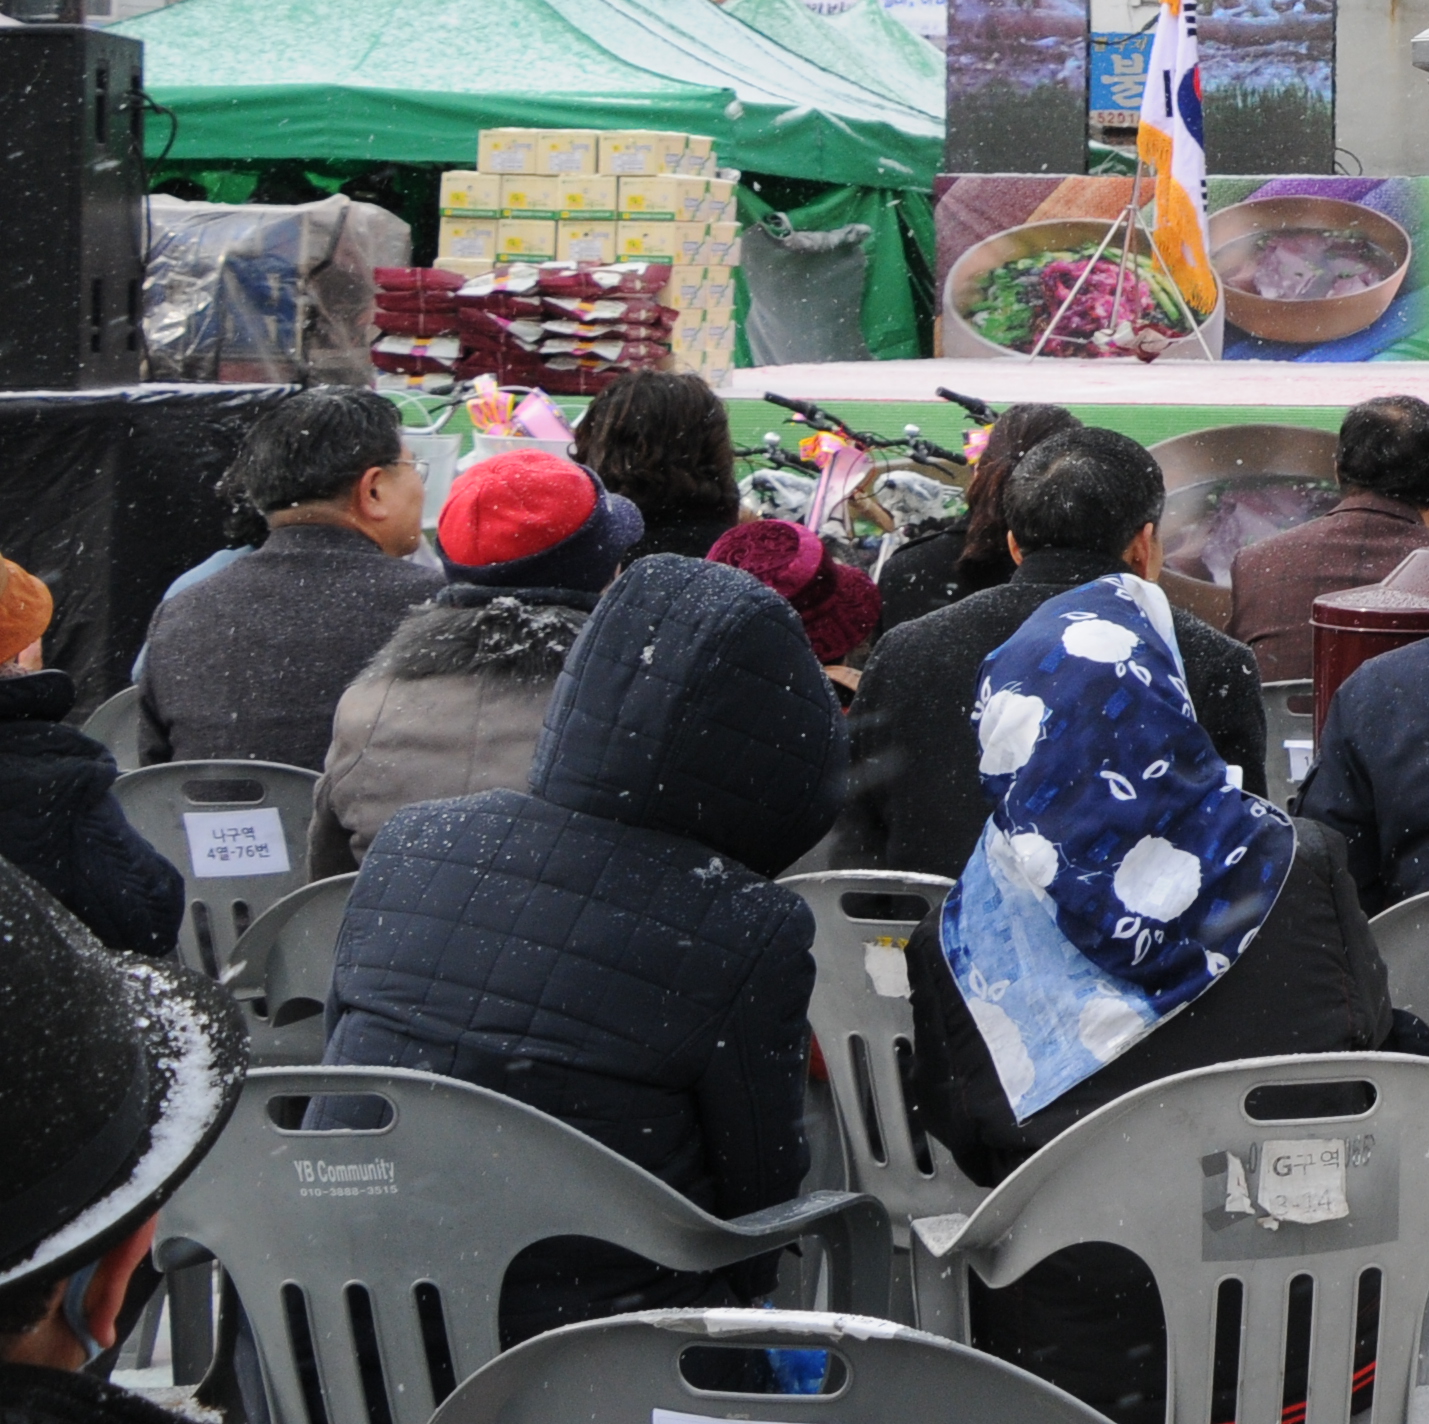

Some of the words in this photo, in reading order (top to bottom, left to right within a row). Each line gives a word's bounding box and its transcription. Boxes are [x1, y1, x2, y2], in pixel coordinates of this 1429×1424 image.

[212, 826, 256, 843] 나구역
[207, 843, 270, 861] 4열-76번
[294, 1160, 315, 1182] YB
[317, 1158, 395, 1182] Community
